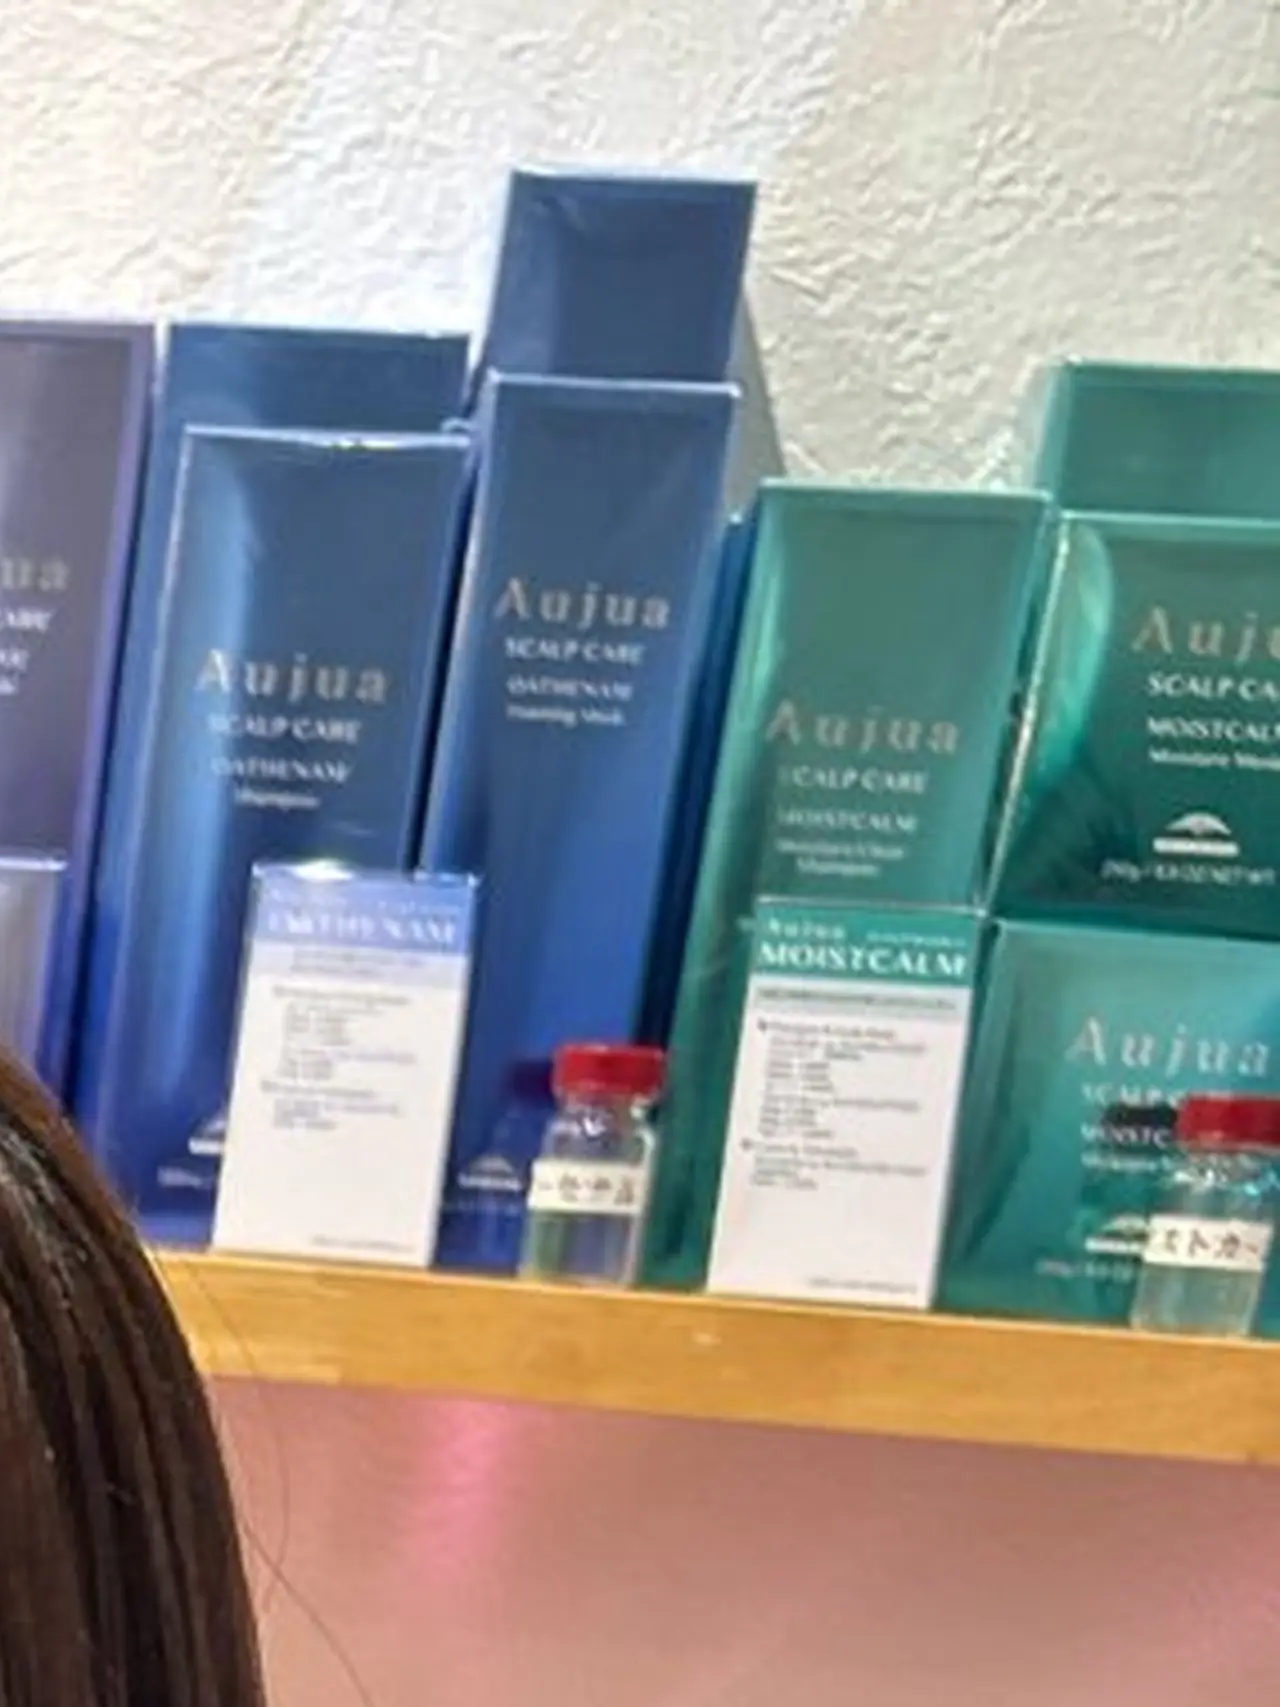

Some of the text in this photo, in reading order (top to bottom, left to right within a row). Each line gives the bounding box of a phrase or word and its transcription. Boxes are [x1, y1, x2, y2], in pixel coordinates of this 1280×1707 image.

[492, 576, 671, 632] Aujua
[504, 635, 646, 668] SCALP CARE
[193, 648, 390, 705] Aujua
[1146, 671, 1236, 698] SCALP
[206, 711, 363, 744] SCALP CARE
[764, 698, 962, 755] Aujua
[757, 938, 969, 978] MOISTCALM
[1062, 1016, 1270, 1080] Aujua
